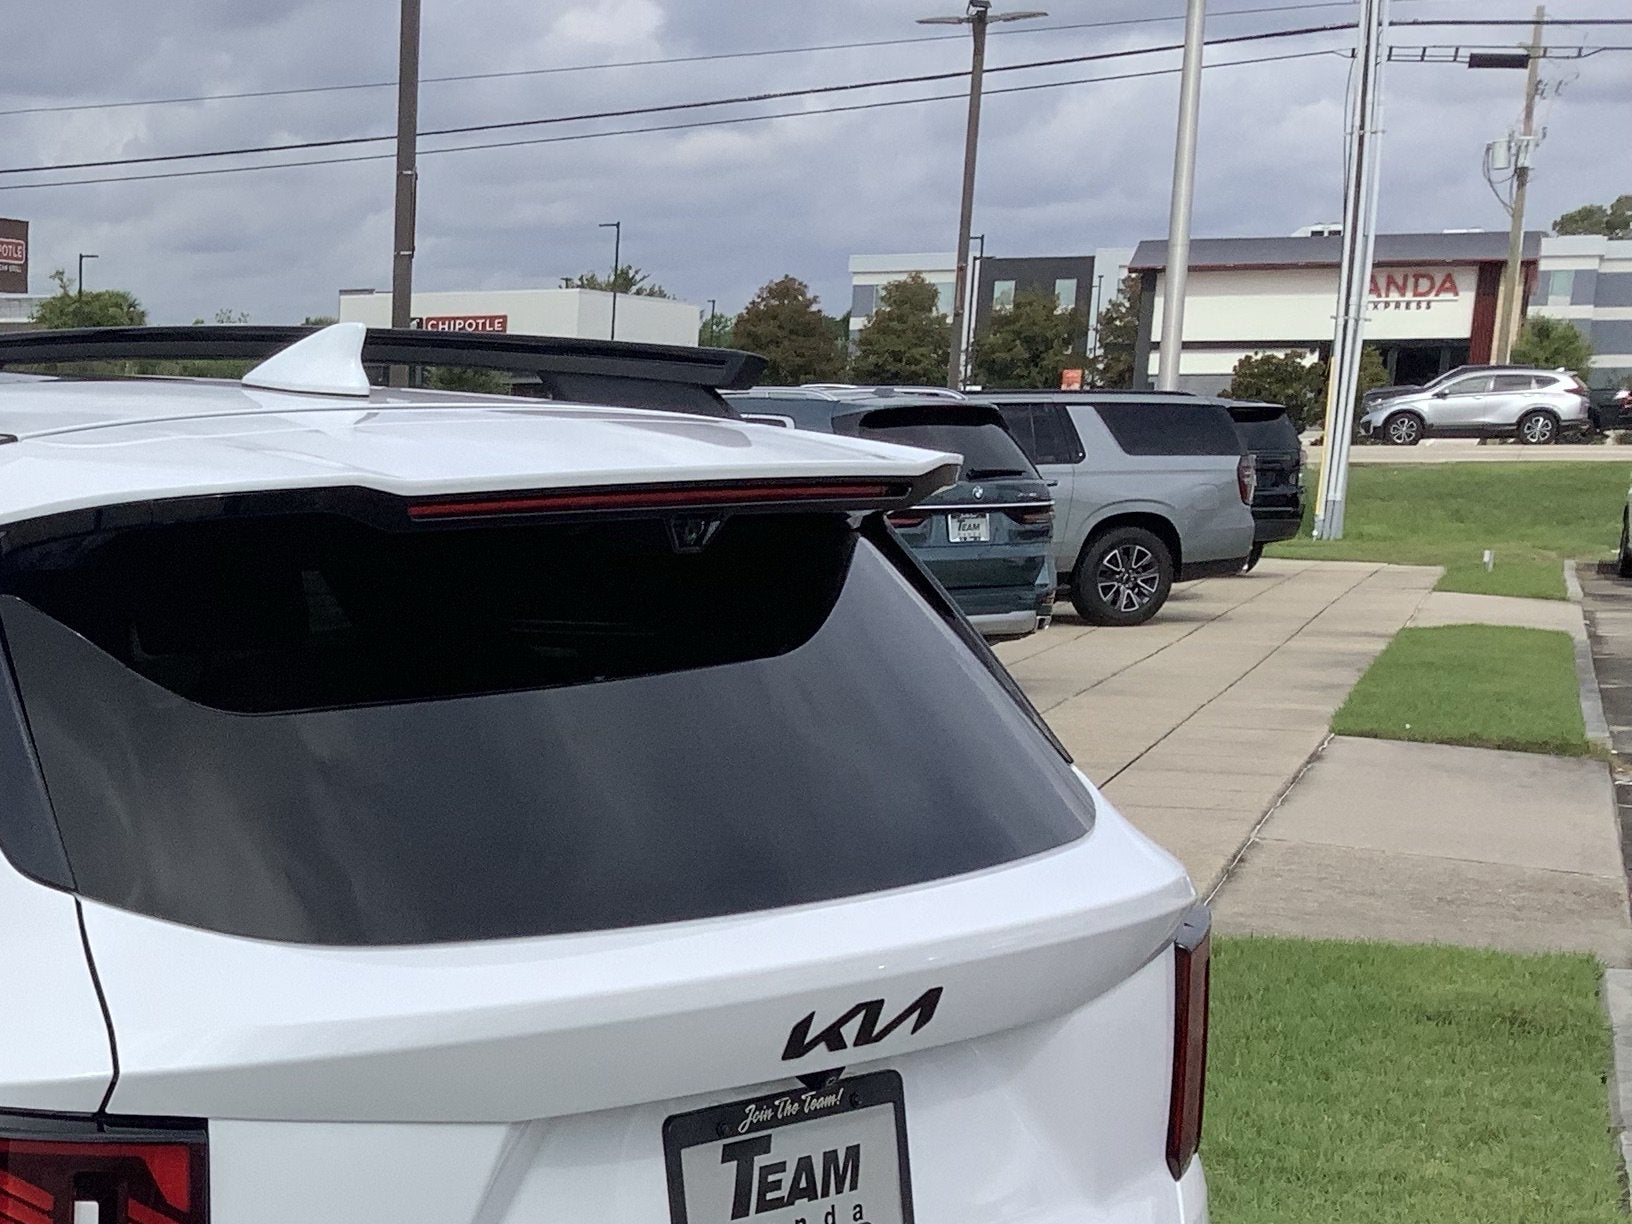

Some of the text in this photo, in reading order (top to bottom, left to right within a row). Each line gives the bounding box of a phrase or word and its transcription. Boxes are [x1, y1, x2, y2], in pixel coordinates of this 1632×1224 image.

[1368, 272, 1460, 298] ANDA
[1367, 301, 1432, 311] XPRESS
[428, 318, 504, 332] CHIPOTLE
[781, 986, 944, 1061] KIA
[737, 1087, 844, 1133] Join The Team!
[721, 1133, 861, 1221] TEAM
